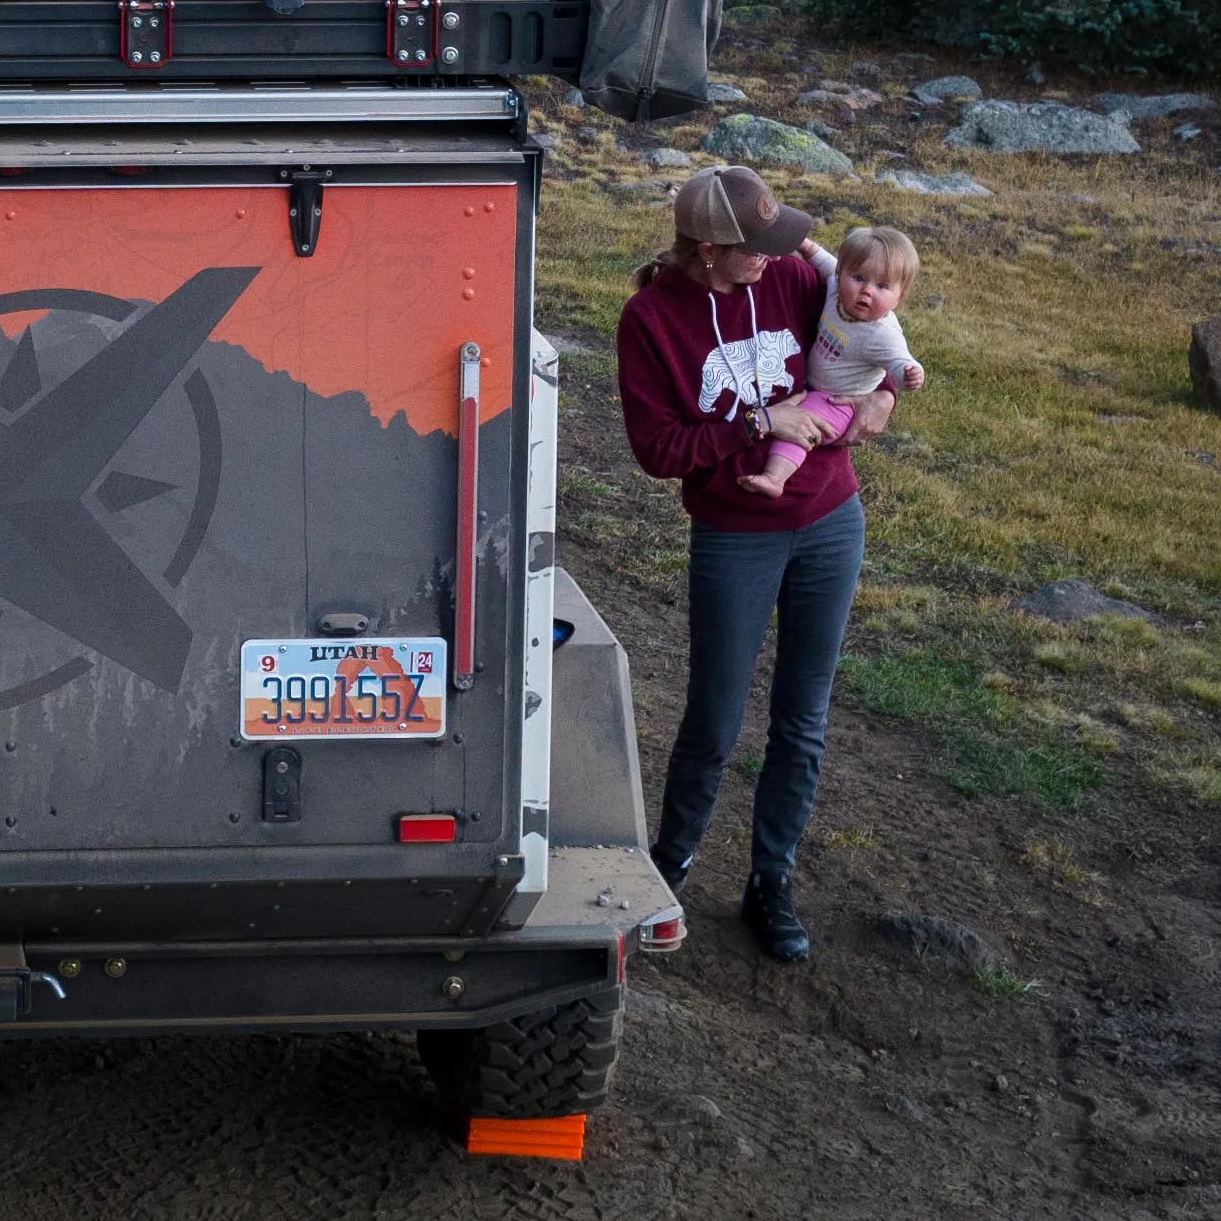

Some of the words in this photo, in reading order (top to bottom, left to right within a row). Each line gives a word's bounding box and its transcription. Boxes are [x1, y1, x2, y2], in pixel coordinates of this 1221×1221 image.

[310, 646, 378, 662] UTAH
[418, 653, 432, 668] 24
[262, 656, 275, 672] 9
[262, 674, 425, 723] 399155Z
